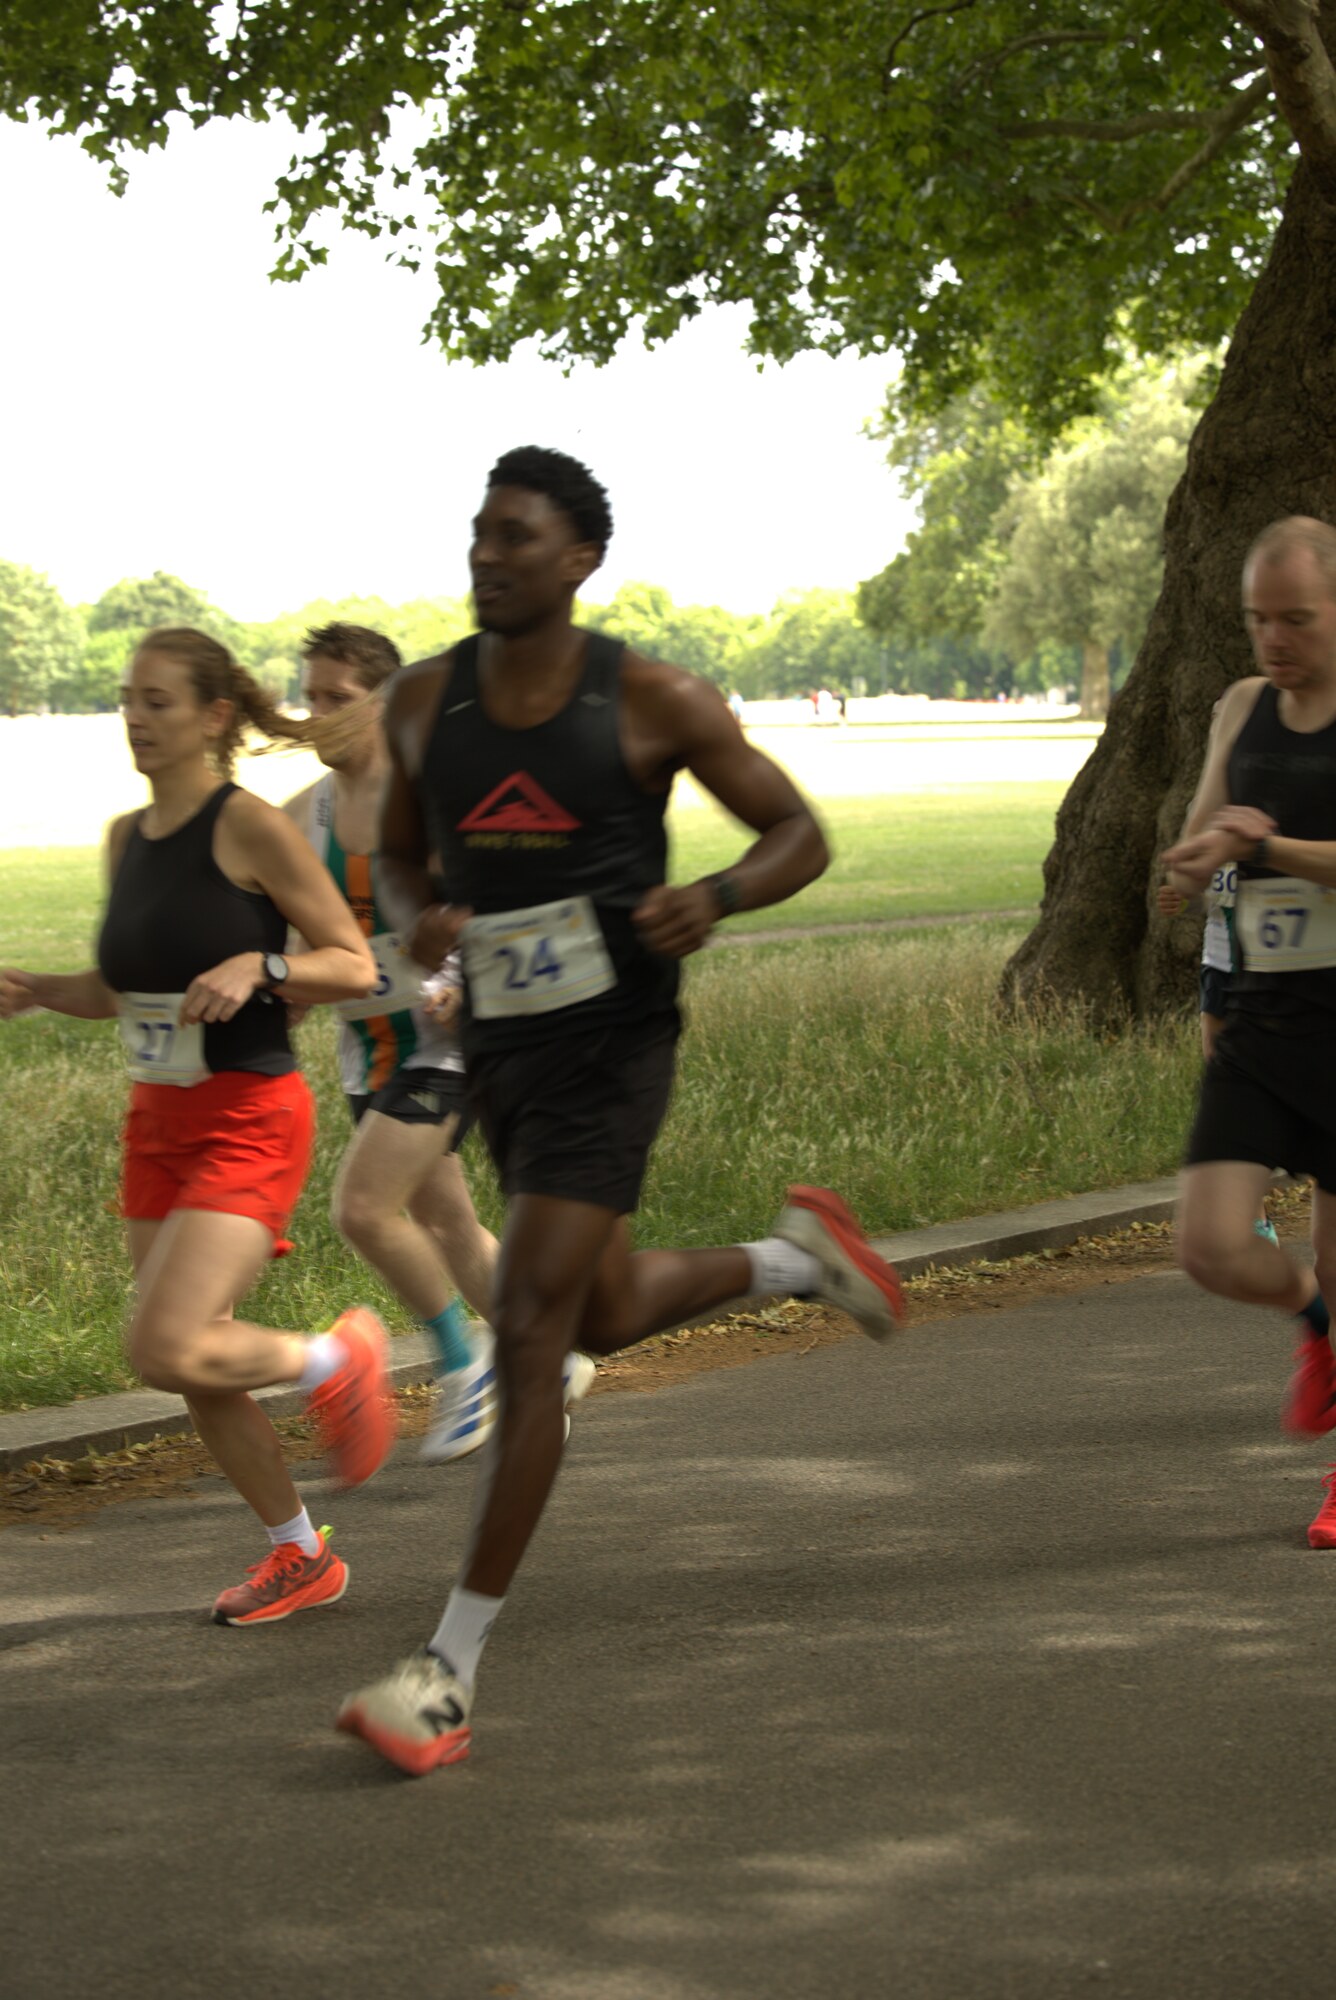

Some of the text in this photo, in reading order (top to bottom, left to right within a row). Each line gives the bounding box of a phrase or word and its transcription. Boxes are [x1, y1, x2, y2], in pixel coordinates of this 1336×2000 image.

[1258, 908, 1311, 949] 67
[493, 936, 566, 990] 24
[136, 1021, 175, 1064] 27
